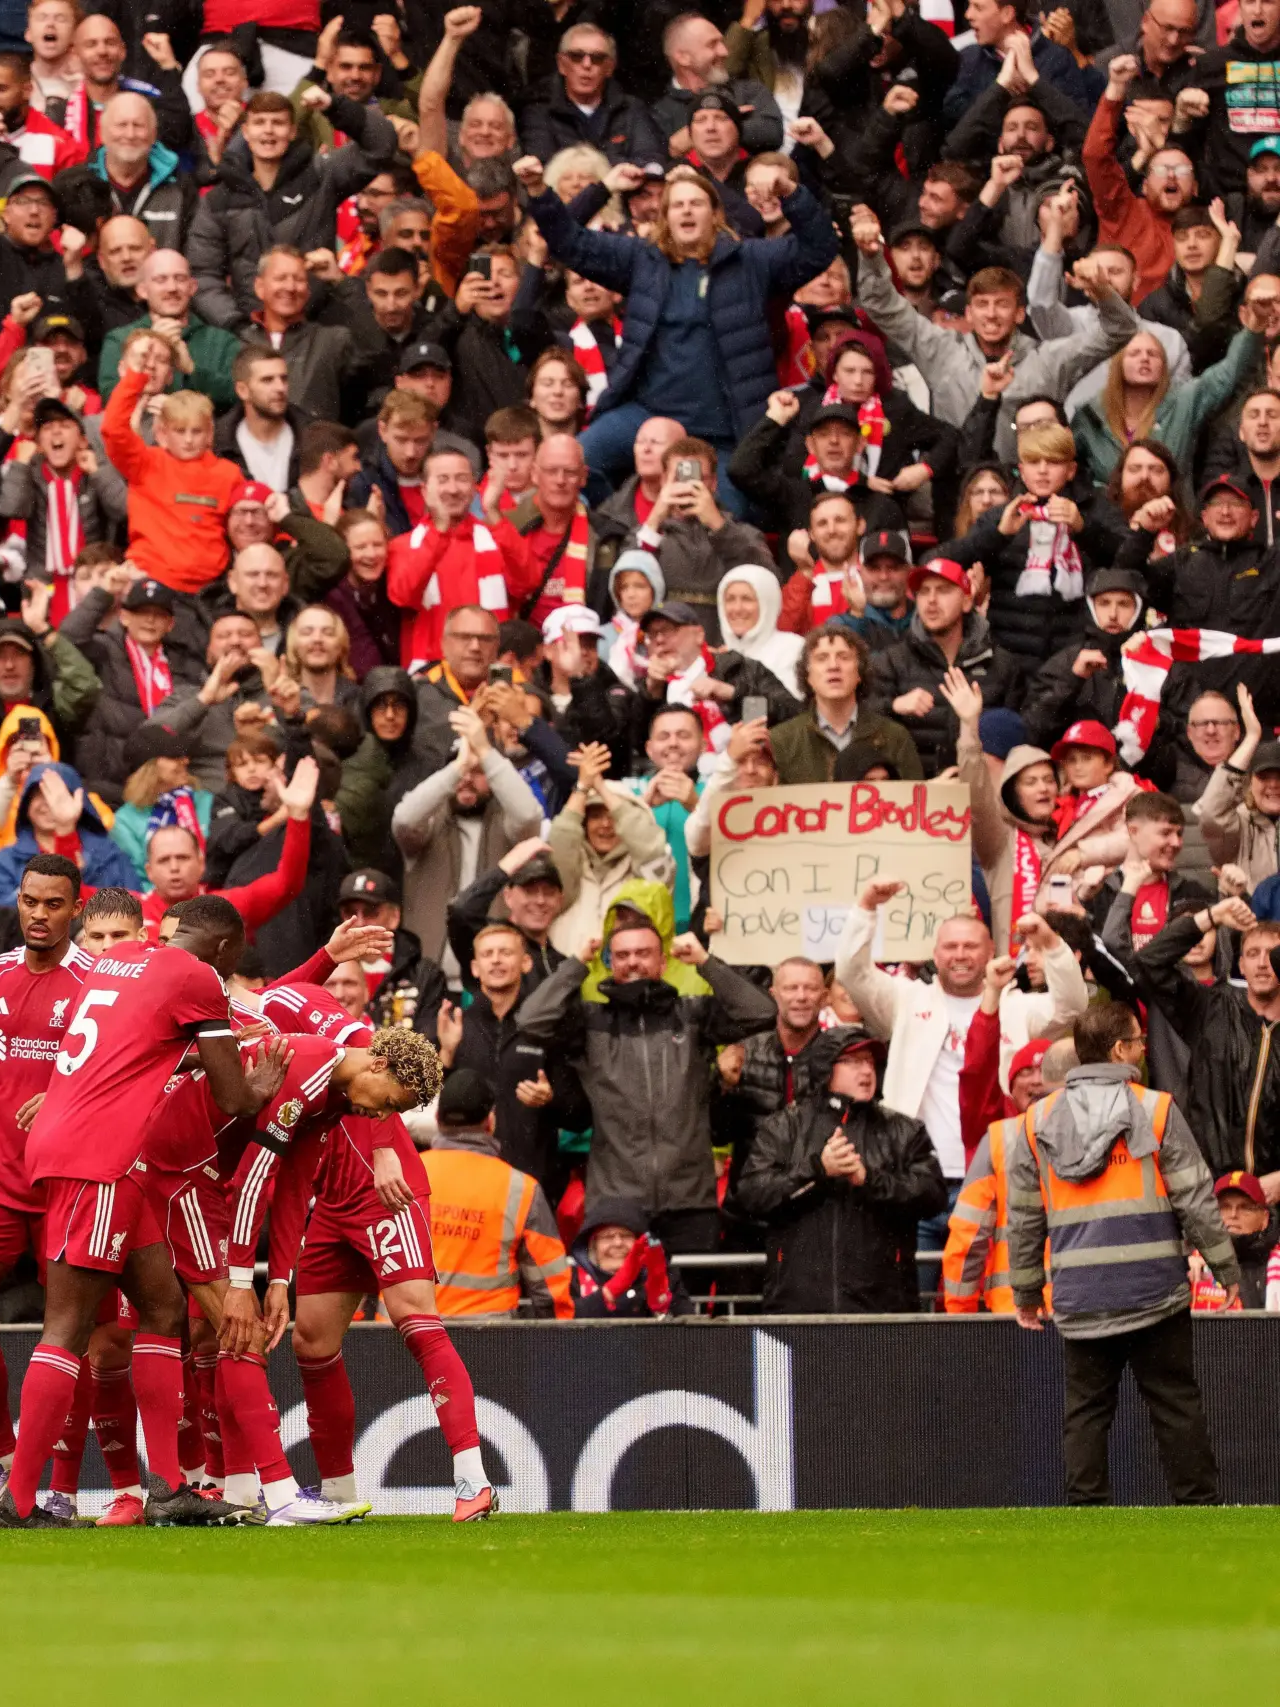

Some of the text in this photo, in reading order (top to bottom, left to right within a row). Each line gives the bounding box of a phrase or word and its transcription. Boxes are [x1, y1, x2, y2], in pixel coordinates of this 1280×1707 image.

[717, 783, 972, 842] Conor Bradley
[717, 848, 790, 898] Can
[800, 863, 832, 893] I
[721, 897, 800, 937] have
[93, 958, 150, 979] KONATÉ
[10, 1036, 60, 1051] standard
[56, 989, 120, 1076] 5
[366, 1219, 402, 1260] 12
[433, 1221, 481, 1241] EWARD
